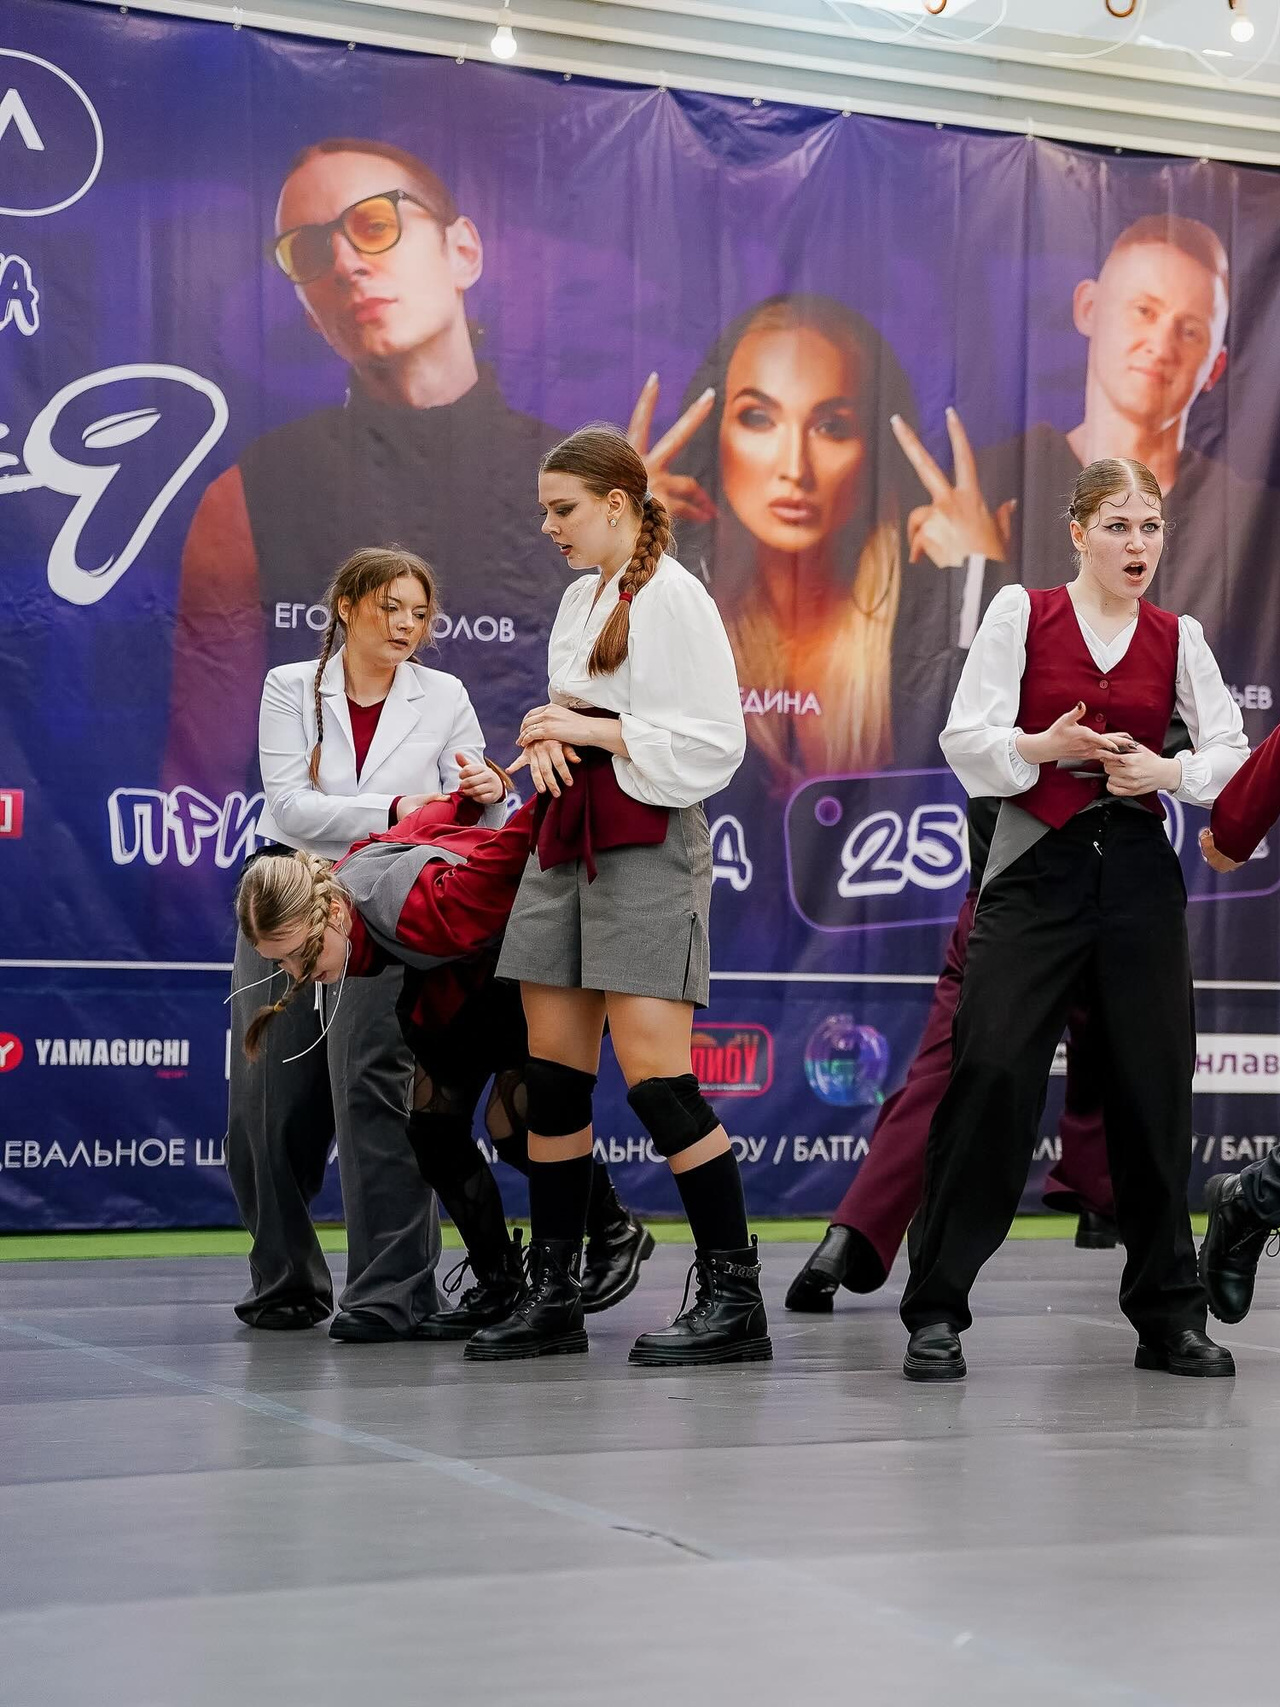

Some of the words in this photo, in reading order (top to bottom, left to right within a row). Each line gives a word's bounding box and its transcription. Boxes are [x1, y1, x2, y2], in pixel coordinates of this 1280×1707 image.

[275, 602, 332, 631] ЕГО
[430, 613, 516, 643] ОЛОВ
[739, 686, 822, 716] ДИНА
[837, 804, 971, 898] 25
[35, 1038, 190, 1067] YAMAGUCHI
[1195, 1052, 1280, 1075] нлав
[0, 1138, 186, 1169] ЕВАЛЬНОЕ
[734, 1136, 768, 1163] ОУ
[793, 1135, 871, 1163] БАТТЛ
